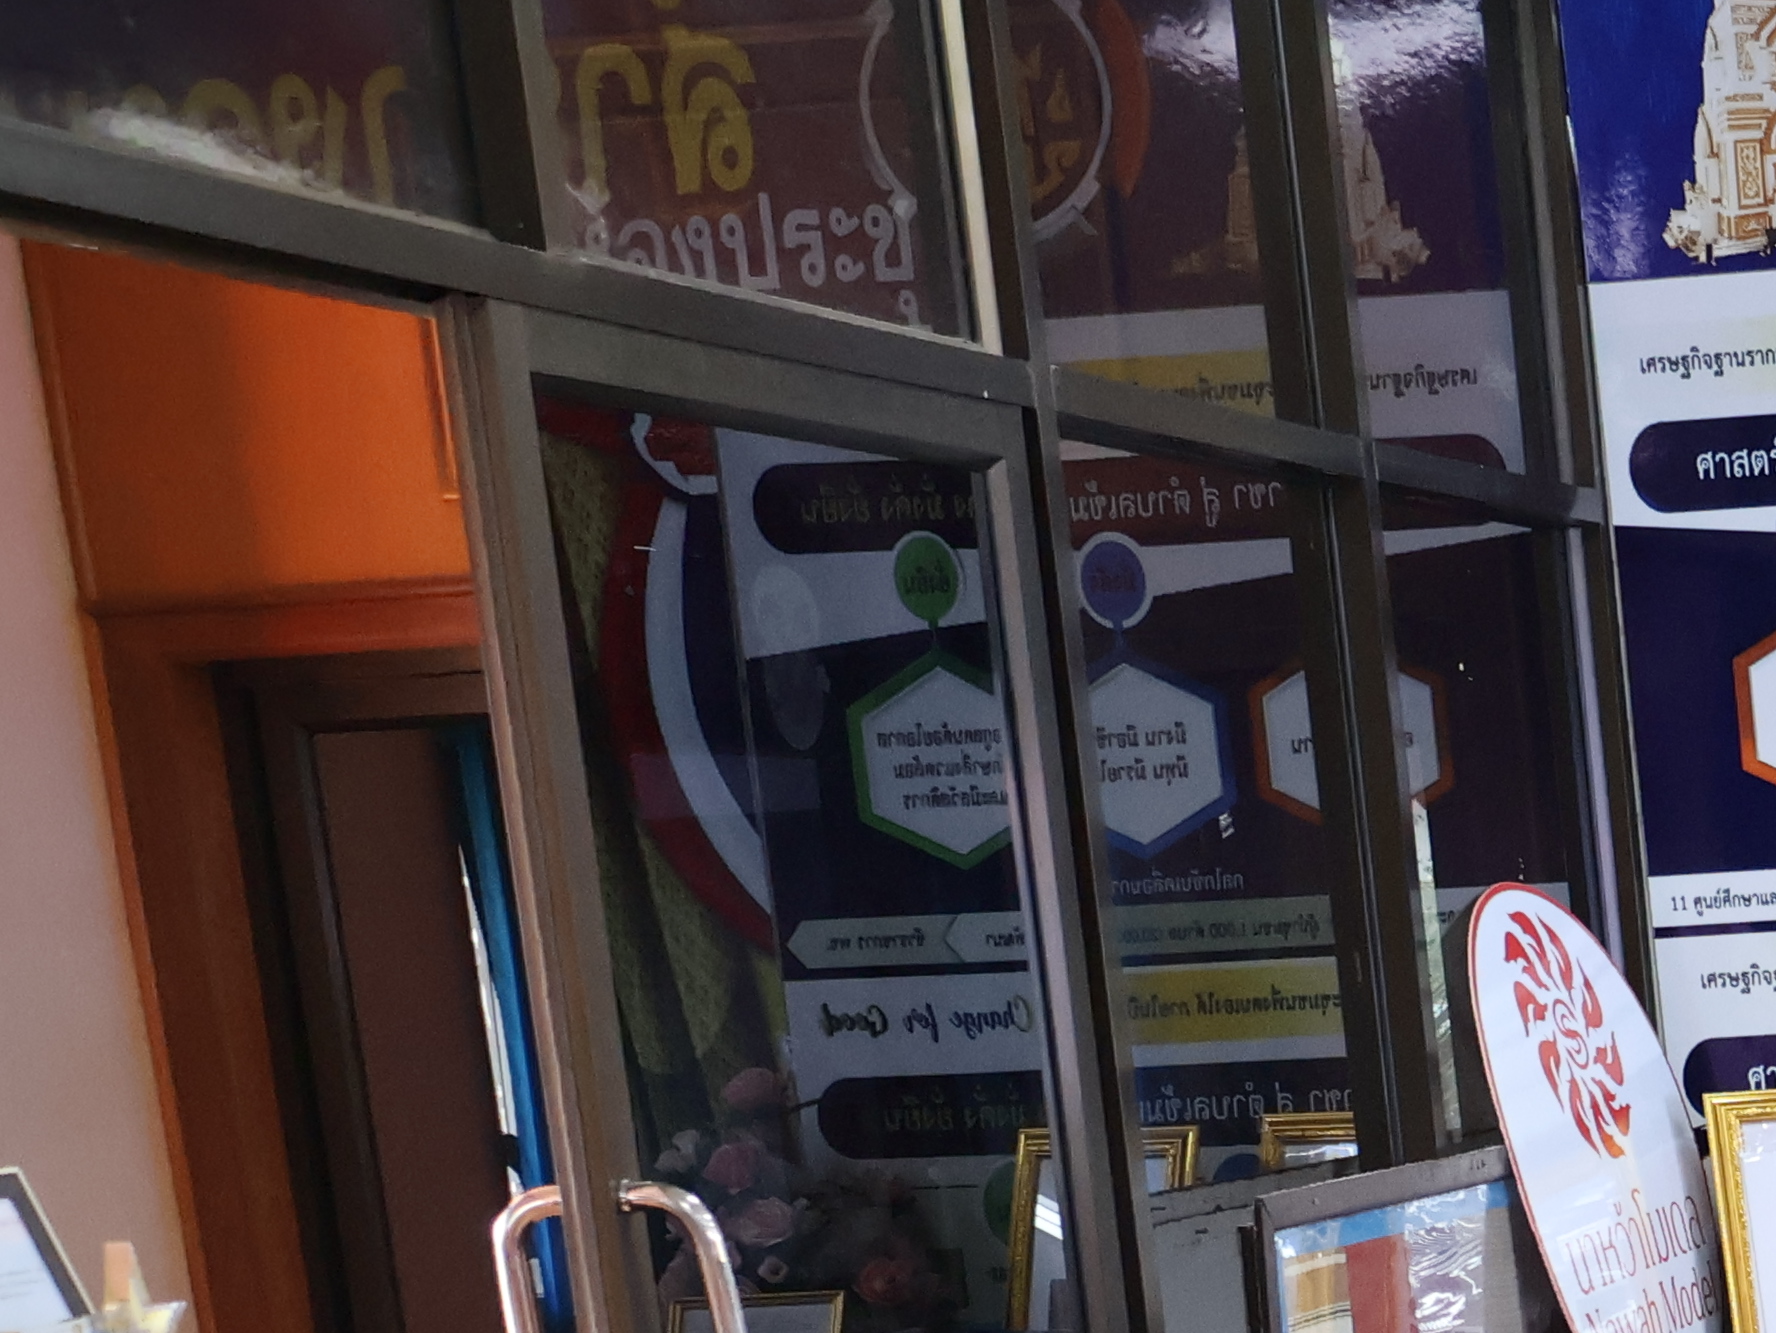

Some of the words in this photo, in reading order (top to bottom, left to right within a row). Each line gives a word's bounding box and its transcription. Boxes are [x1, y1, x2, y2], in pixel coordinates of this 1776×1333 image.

[1670, 895, 1688, 912] 11
[1565, 1187, 1708, 1296] นาหว้าโมเดล
